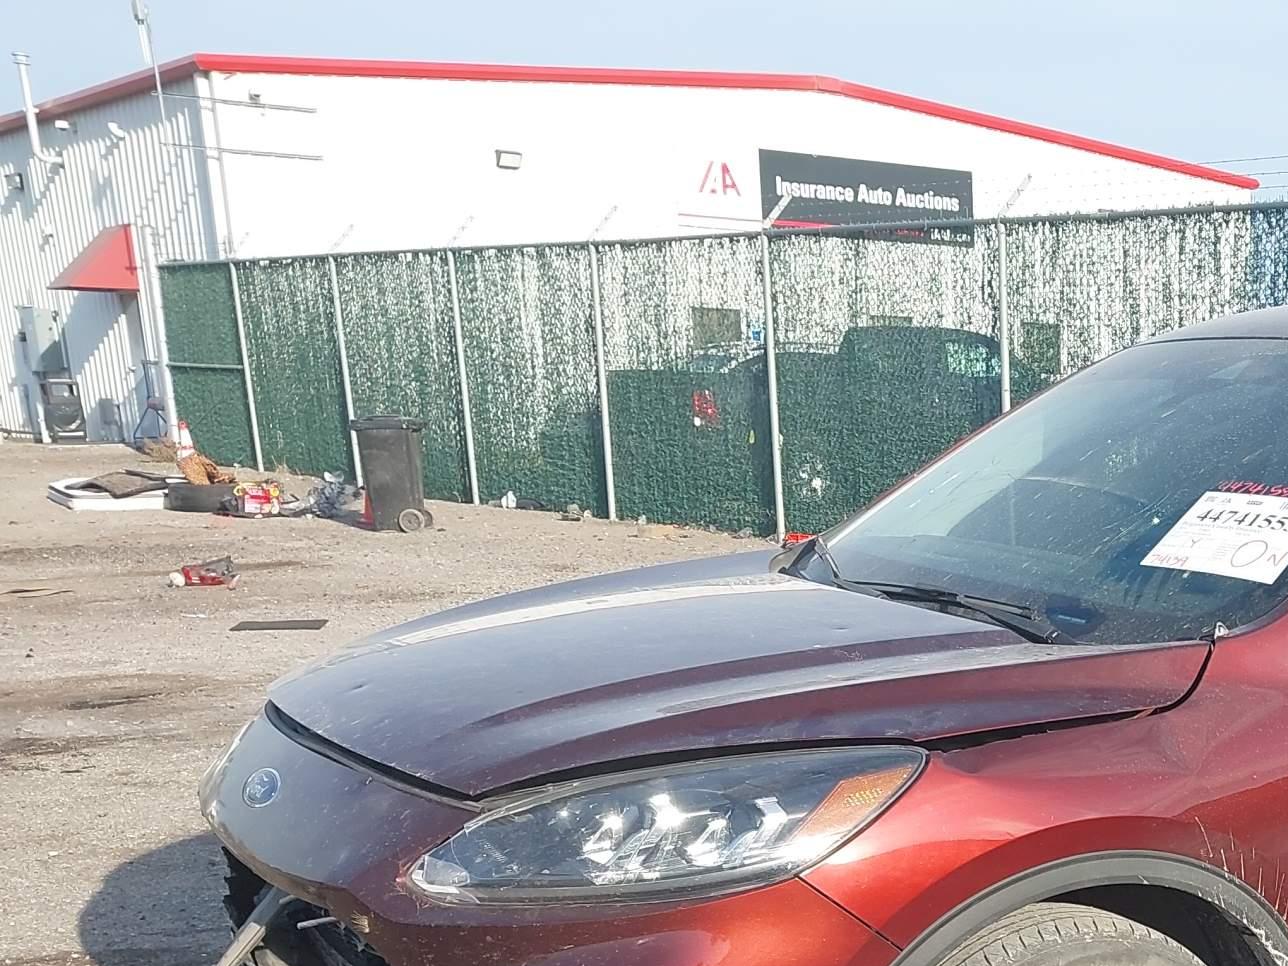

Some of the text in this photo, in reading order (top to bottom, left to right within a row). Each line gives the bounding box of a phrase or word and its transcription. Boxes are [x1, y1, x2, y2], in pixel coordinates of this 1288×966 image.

[775, 176, 960, 212] Insurance Auto Auctions
